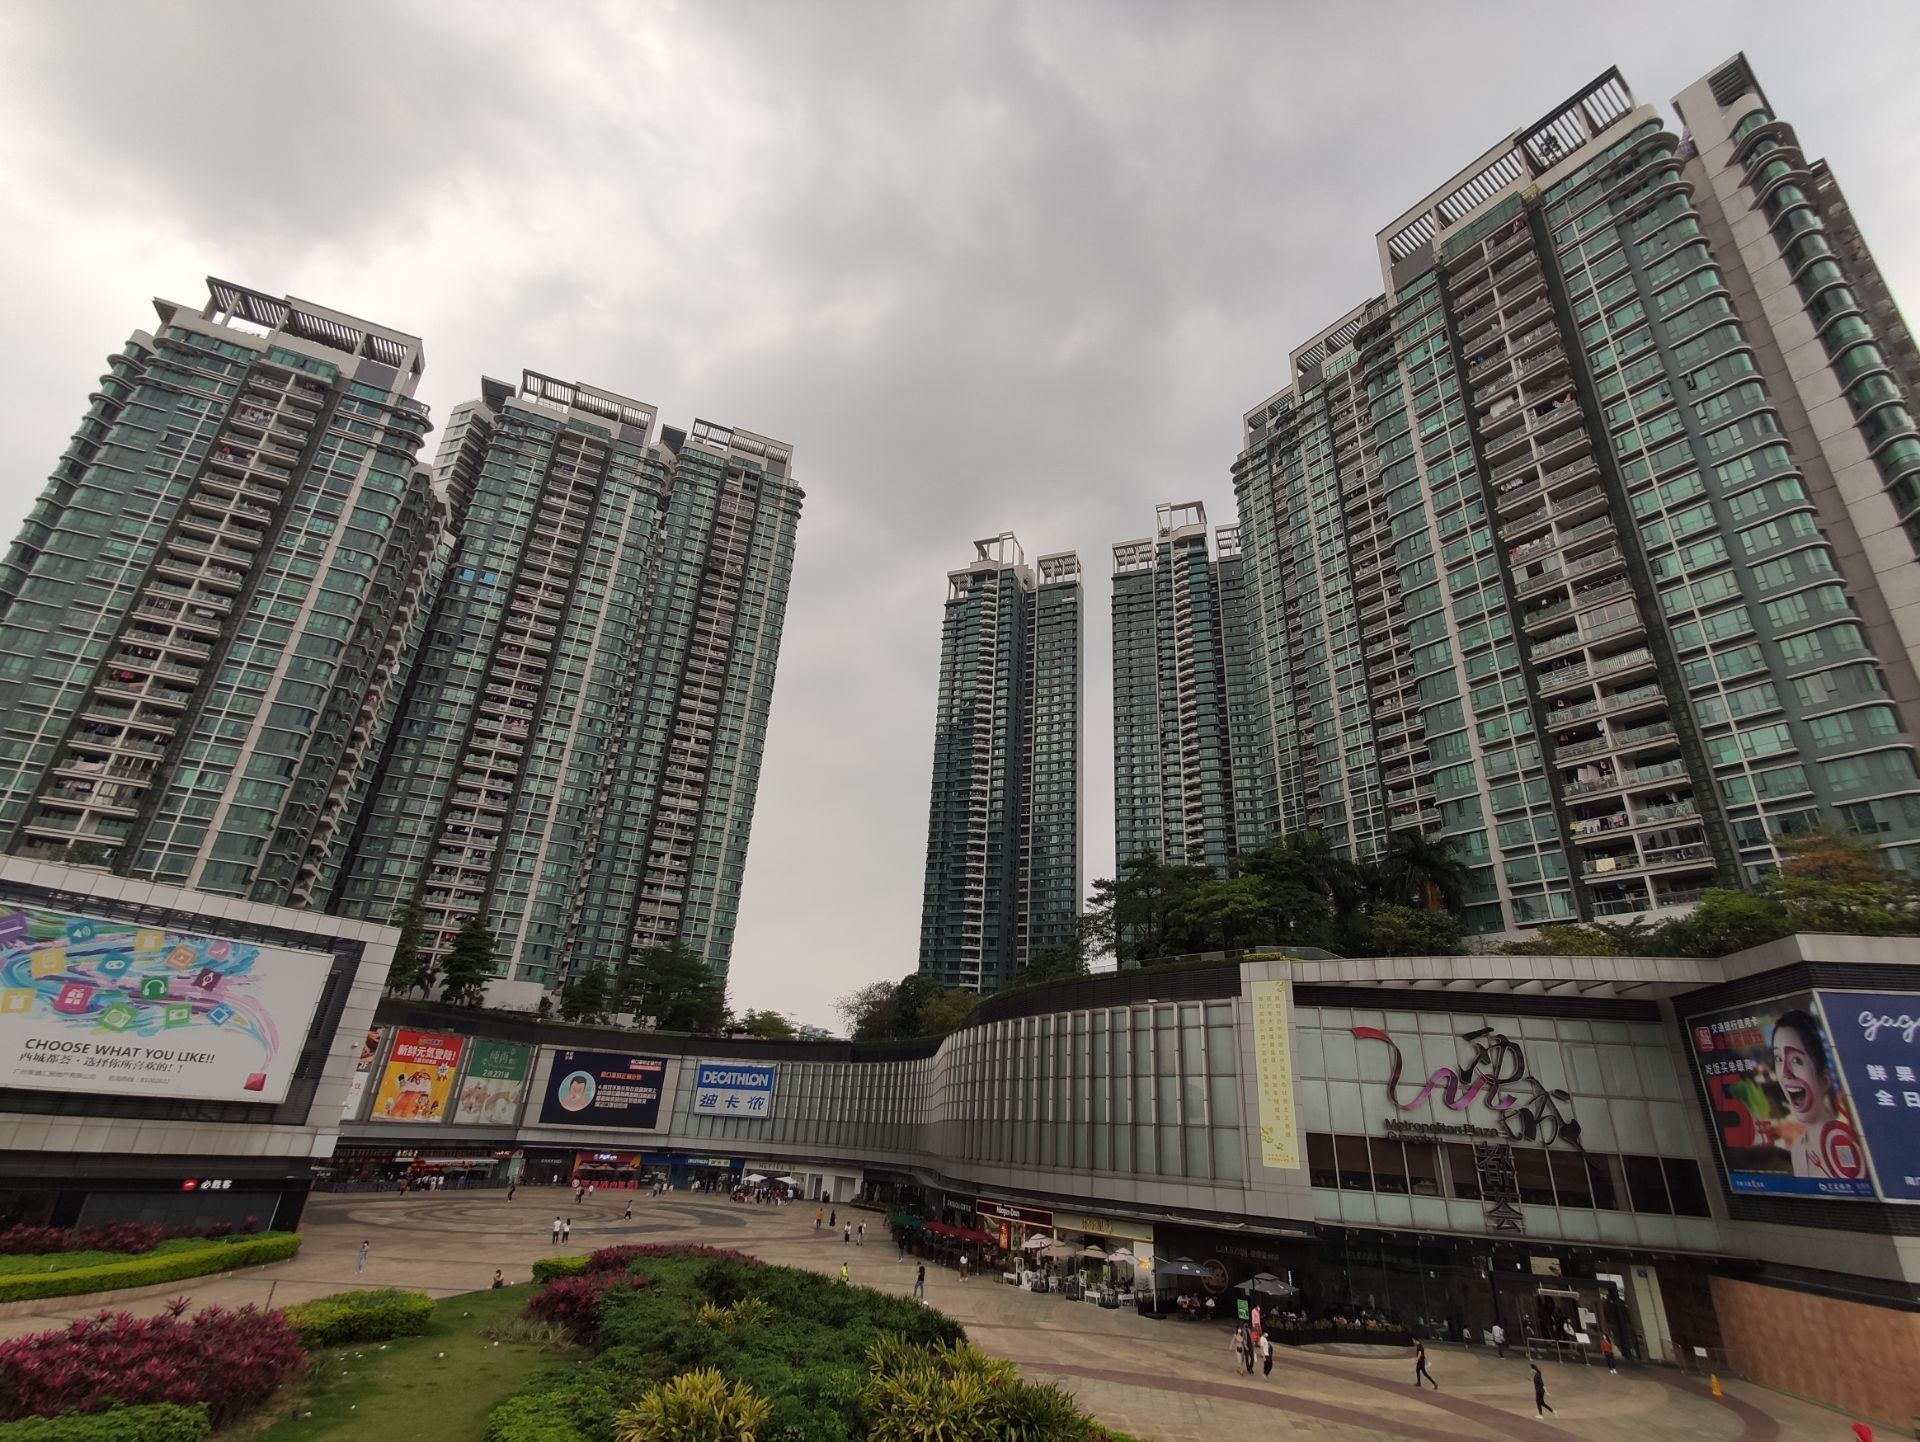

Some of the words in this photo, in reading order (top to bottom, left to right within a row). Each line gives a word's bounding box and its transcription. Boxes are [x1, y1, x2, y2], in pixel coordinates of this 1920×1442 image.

[1711, 1016, 1760, 1034] 交通银行信用卡
[1858, 1010, 1920, 1043] gag
[24, 1038, 91, 1054] CHOOSE
[95, 1045, 142, 1058] WHAT
[144, 1048, 175, 1061] YOU
[177, 1052, 215, 1064] LIKE!!
[702, 1070, 769, 1087] DECATHLON
[699, 1093, 766, 1111] 迪卡侬
[1384, 1118, 1463, 1134] Metropolitan
[1464, 1123, 1499, 1137] Plaza
